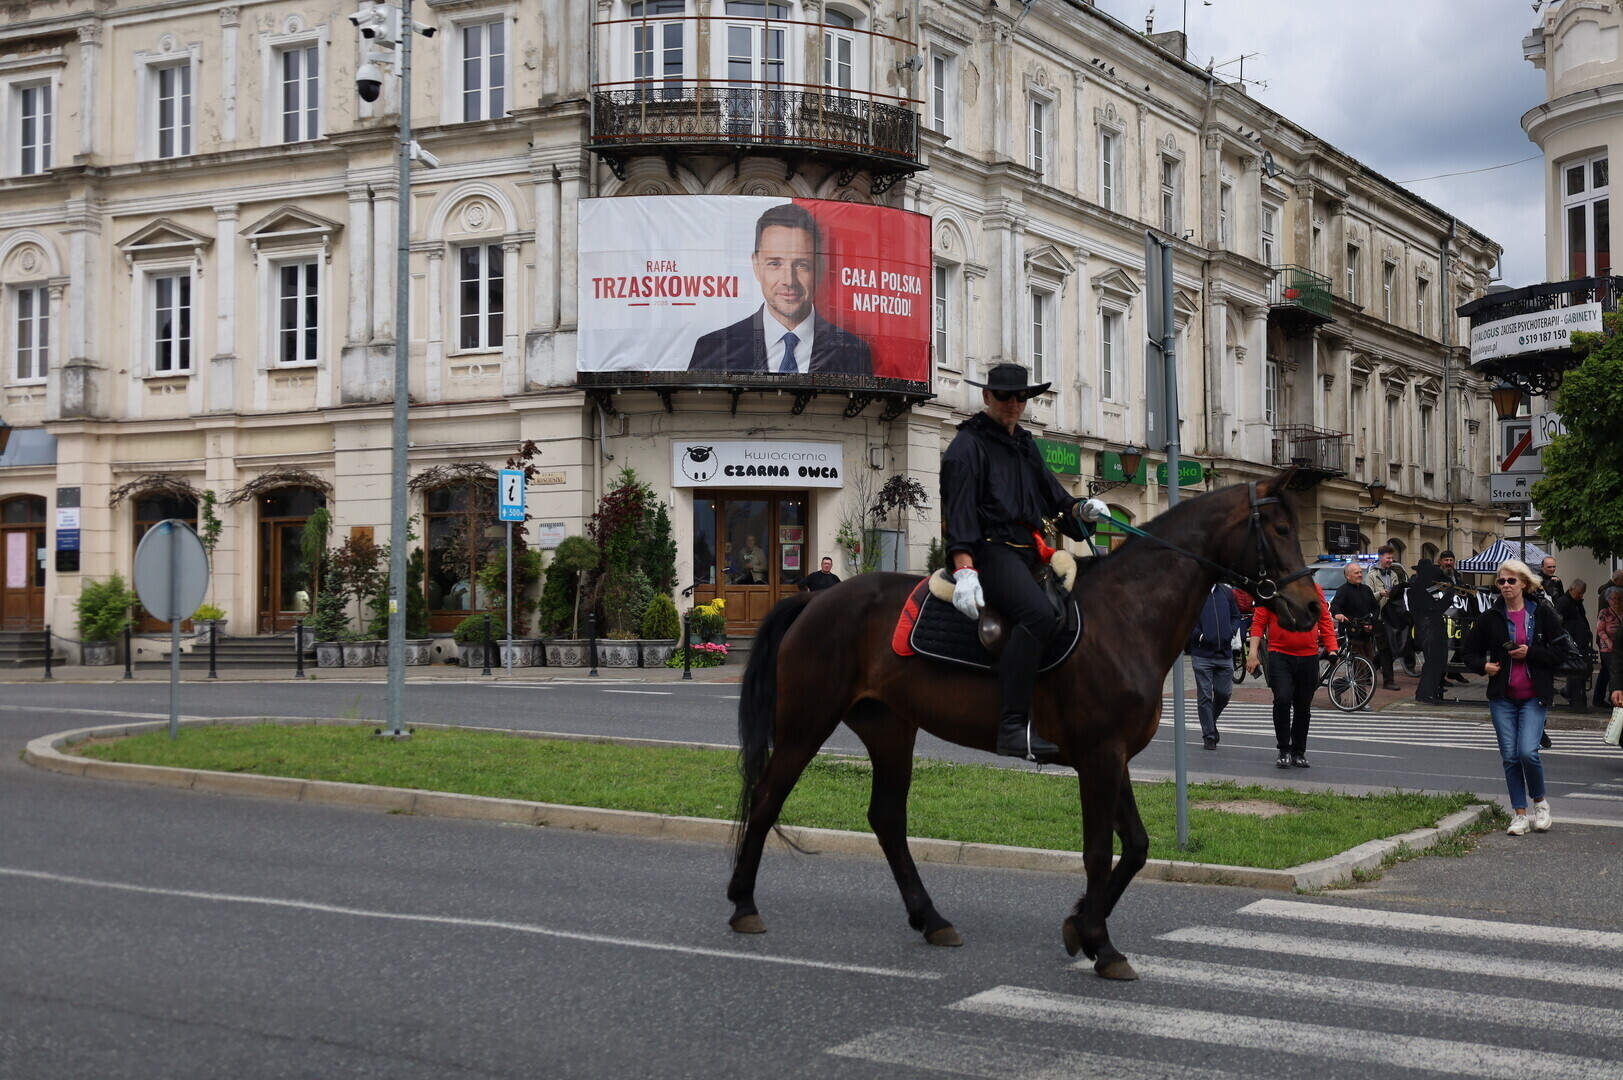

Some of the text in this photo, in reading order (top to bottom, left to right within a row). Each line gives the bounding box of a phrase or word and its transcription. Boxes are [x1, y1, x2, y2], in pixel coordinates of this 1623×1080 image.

[646, 260, 678, 273] RAFAŁ
[592, 275, 739, 299] TRZASKOWSKI
[841, 267, 922, 295] CAŁA POLSKA
[853, 292, 912, 317] NAPRZÓD!
[1474, 327, 1500, 343] DIALOGUS
[1500, 322, 1517, 336] ZACISZE
[1517, 315, 1560, 332] PSYCHOTERAPII
[1564, 310, 1598, 325] GABINETY
[1525, 329, 1567, 345] 519 187 150
[744, 449, 827, 462] kwiaciarnia
[1045, 444, 1076, 467] żabka
[724, 464, 839, 479] CZARNA OWCA
[1492, 489, 1521, 498] Strefa
